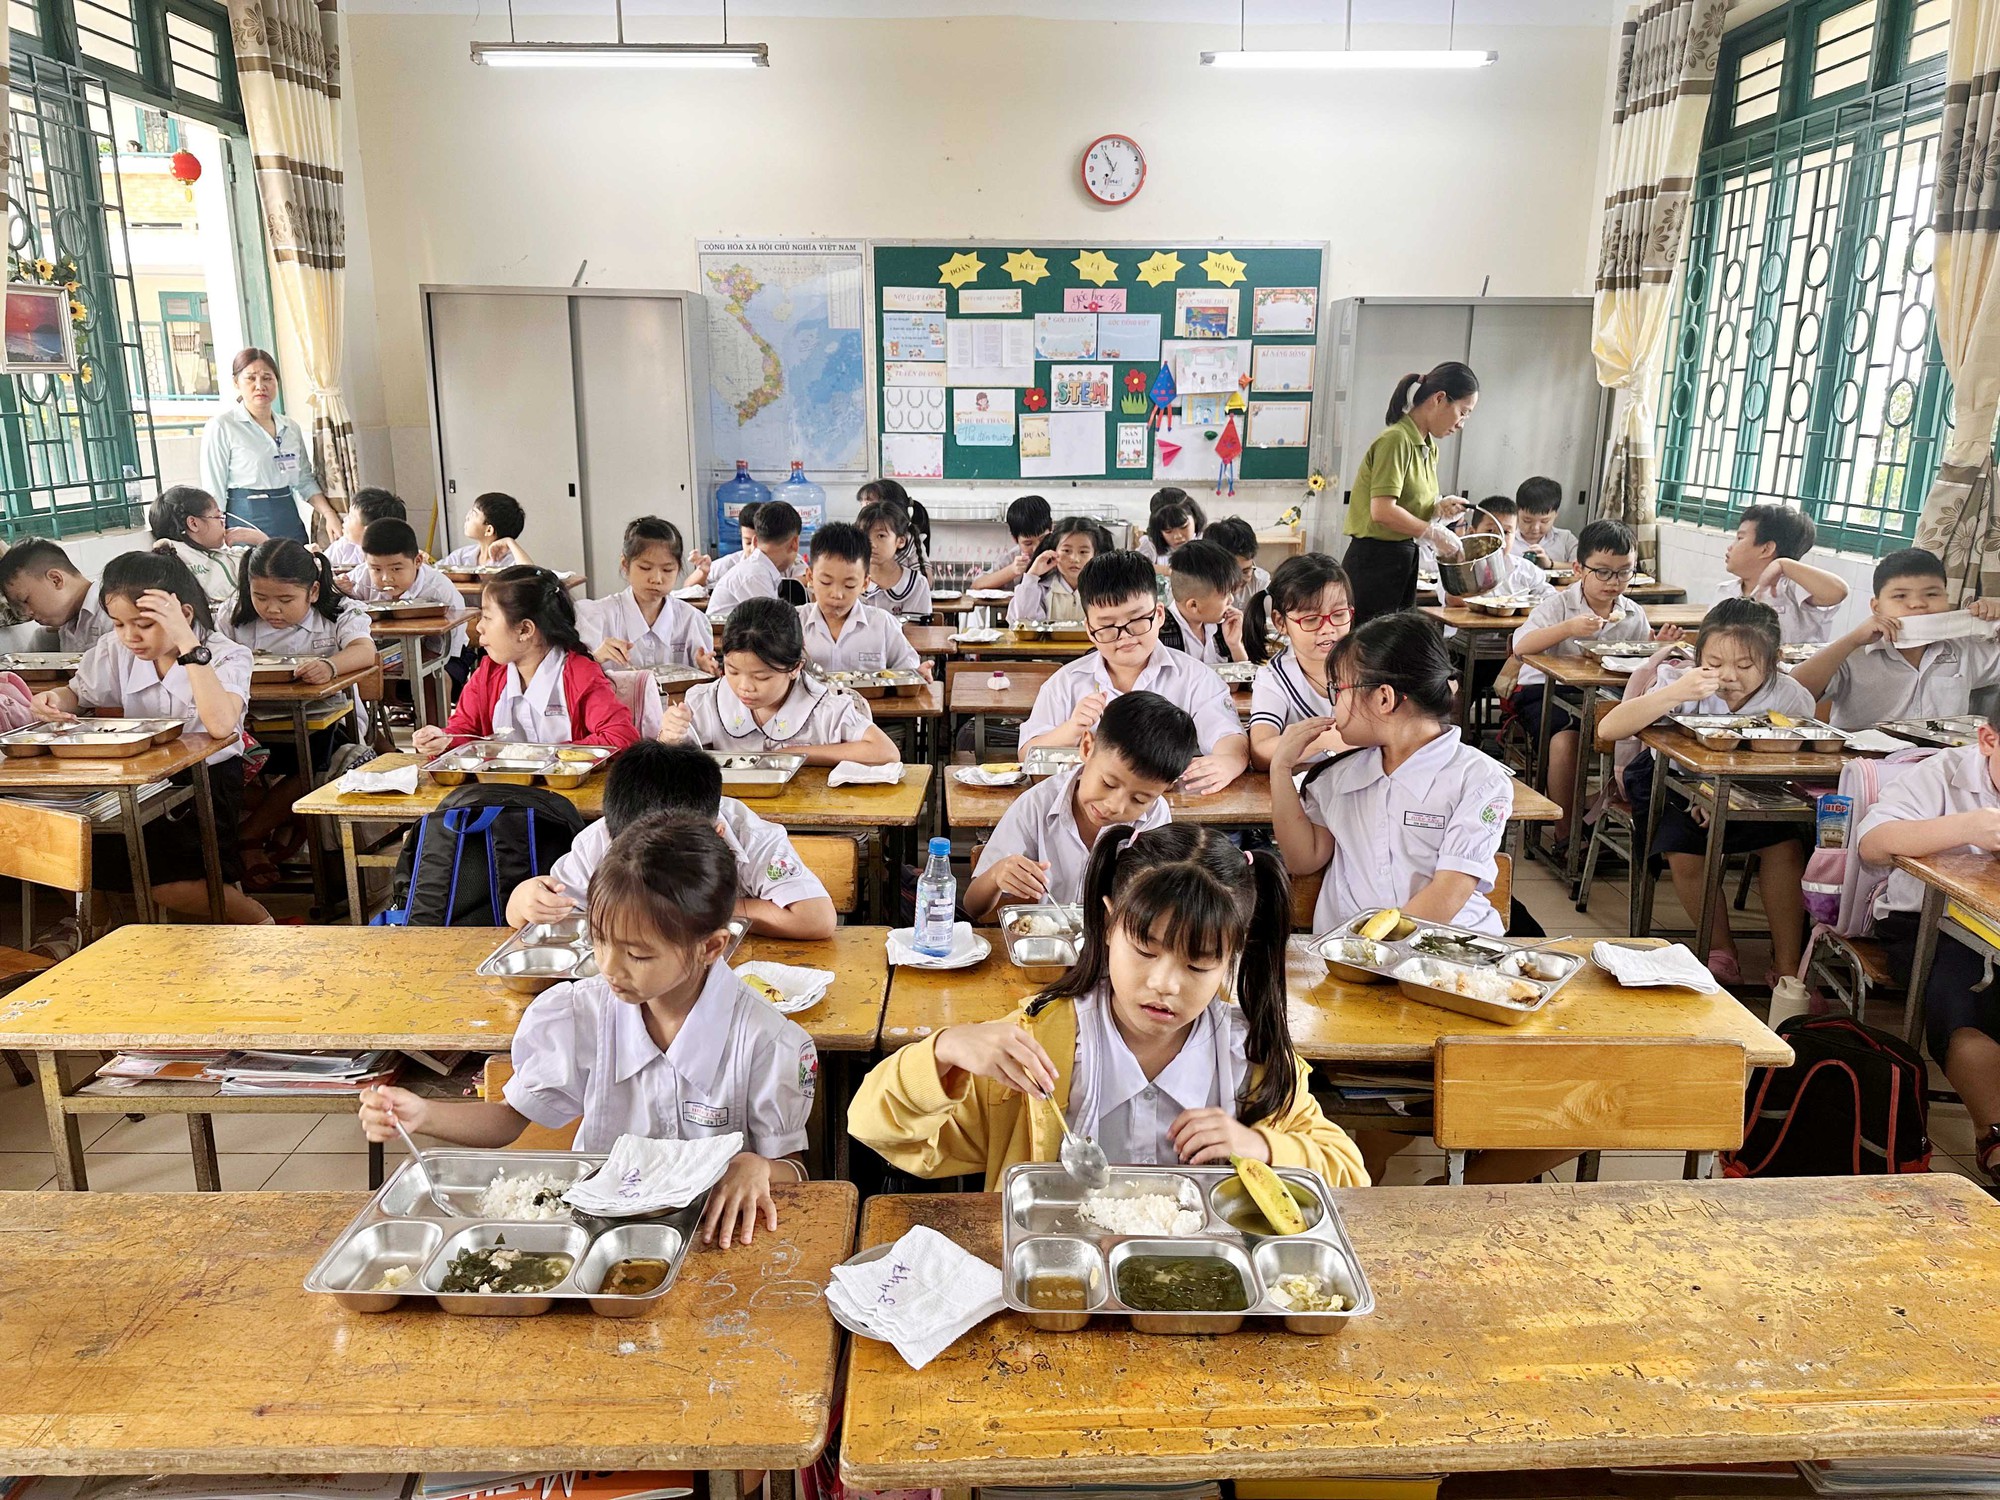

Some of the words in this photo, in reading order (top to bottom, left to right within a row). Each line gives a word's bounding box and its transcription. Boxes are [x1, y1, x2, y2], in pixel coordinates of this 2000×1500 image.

[704, 243, 725, 251] CỘNG
[727, 242, 743, 250] HÒA
[745, 242, 757, 250] XÃ
[759, 242, 772, 251] HỘI
[774, 241, 790, 250] CHỦ
[792, 243, 817, 251] NGHĨA
[819, 243, 837, 251] VIỆT
[1057, 381, 1109, 406] STEM
